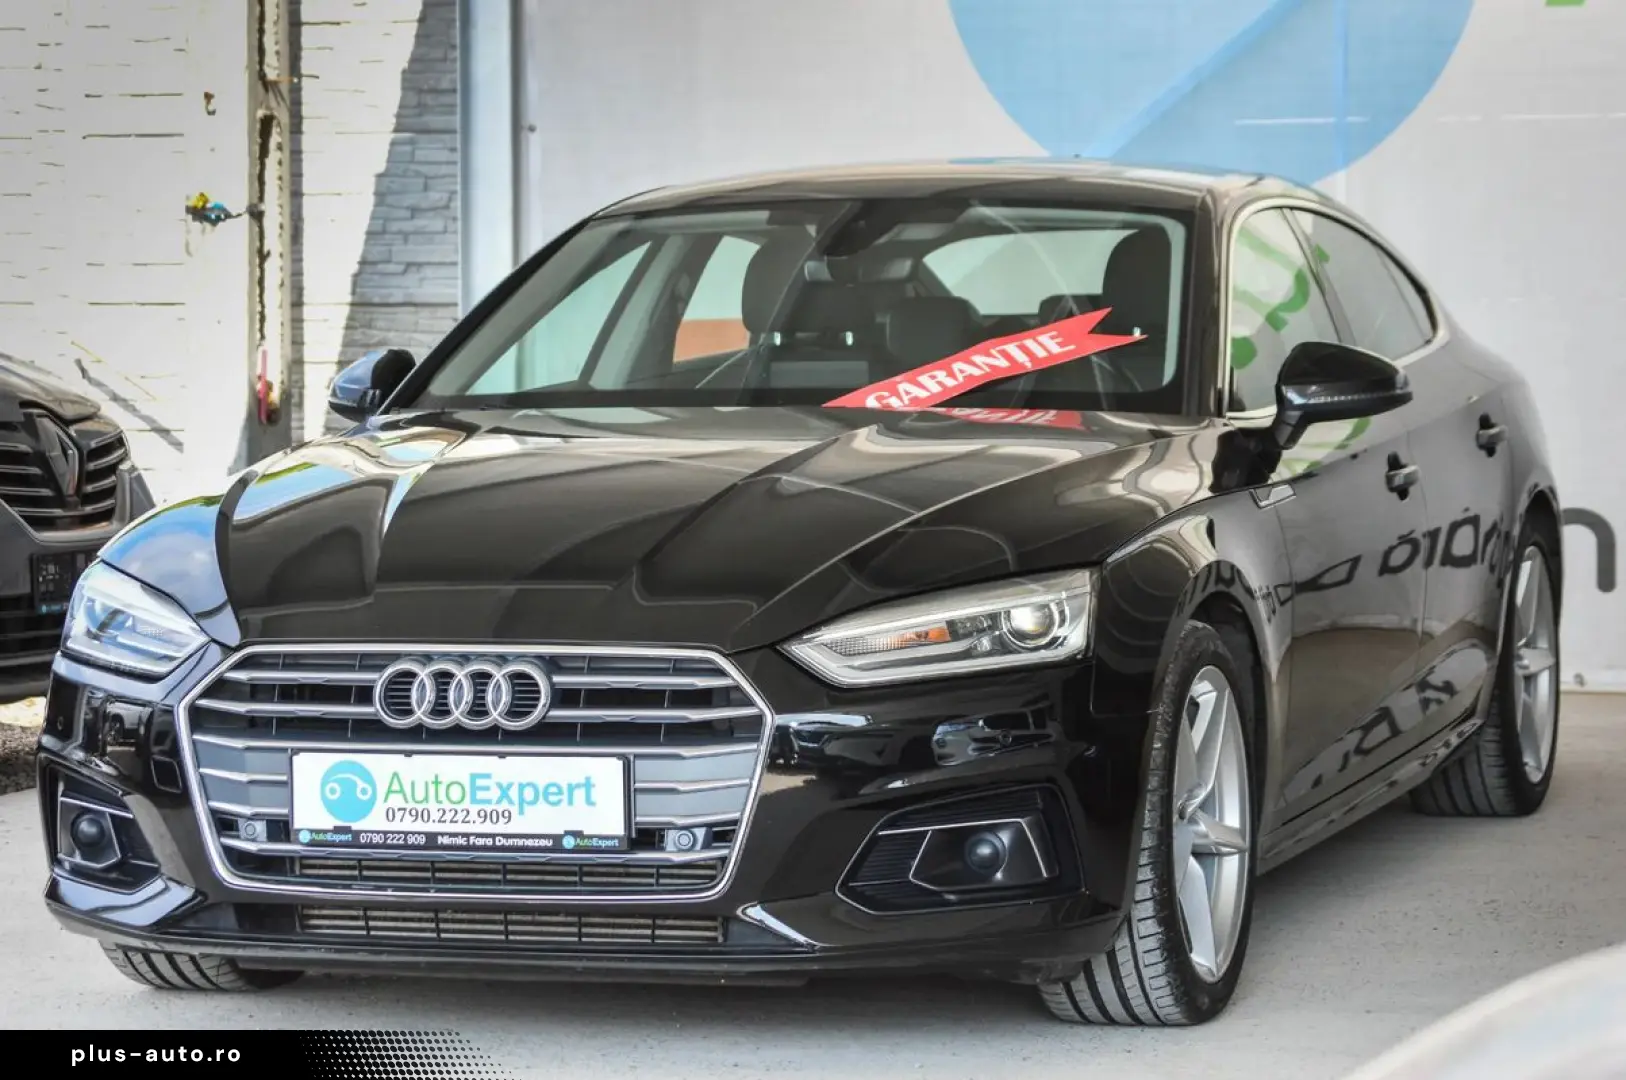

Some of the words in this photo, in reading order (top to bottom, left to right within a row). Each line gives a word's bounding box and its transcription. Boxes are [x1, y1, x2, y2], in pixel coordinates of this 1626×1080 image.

[383, 771, 597, 815] AutoExpert
[385, 806, 512, 825] 0790.222.909
[310, 831, 352, 843] AutoExpert
[360, 832, 384, 844] 0790
[386, 833, 405, 845] 222
[407, 833, 426, 845] 909
[437, 834, 467, 846] Nimic
[469, 835, 493, 847] Fara
[495, 836, 553, 847] Dumnezeu
[575, 837, 619, 849] AutoExpert
